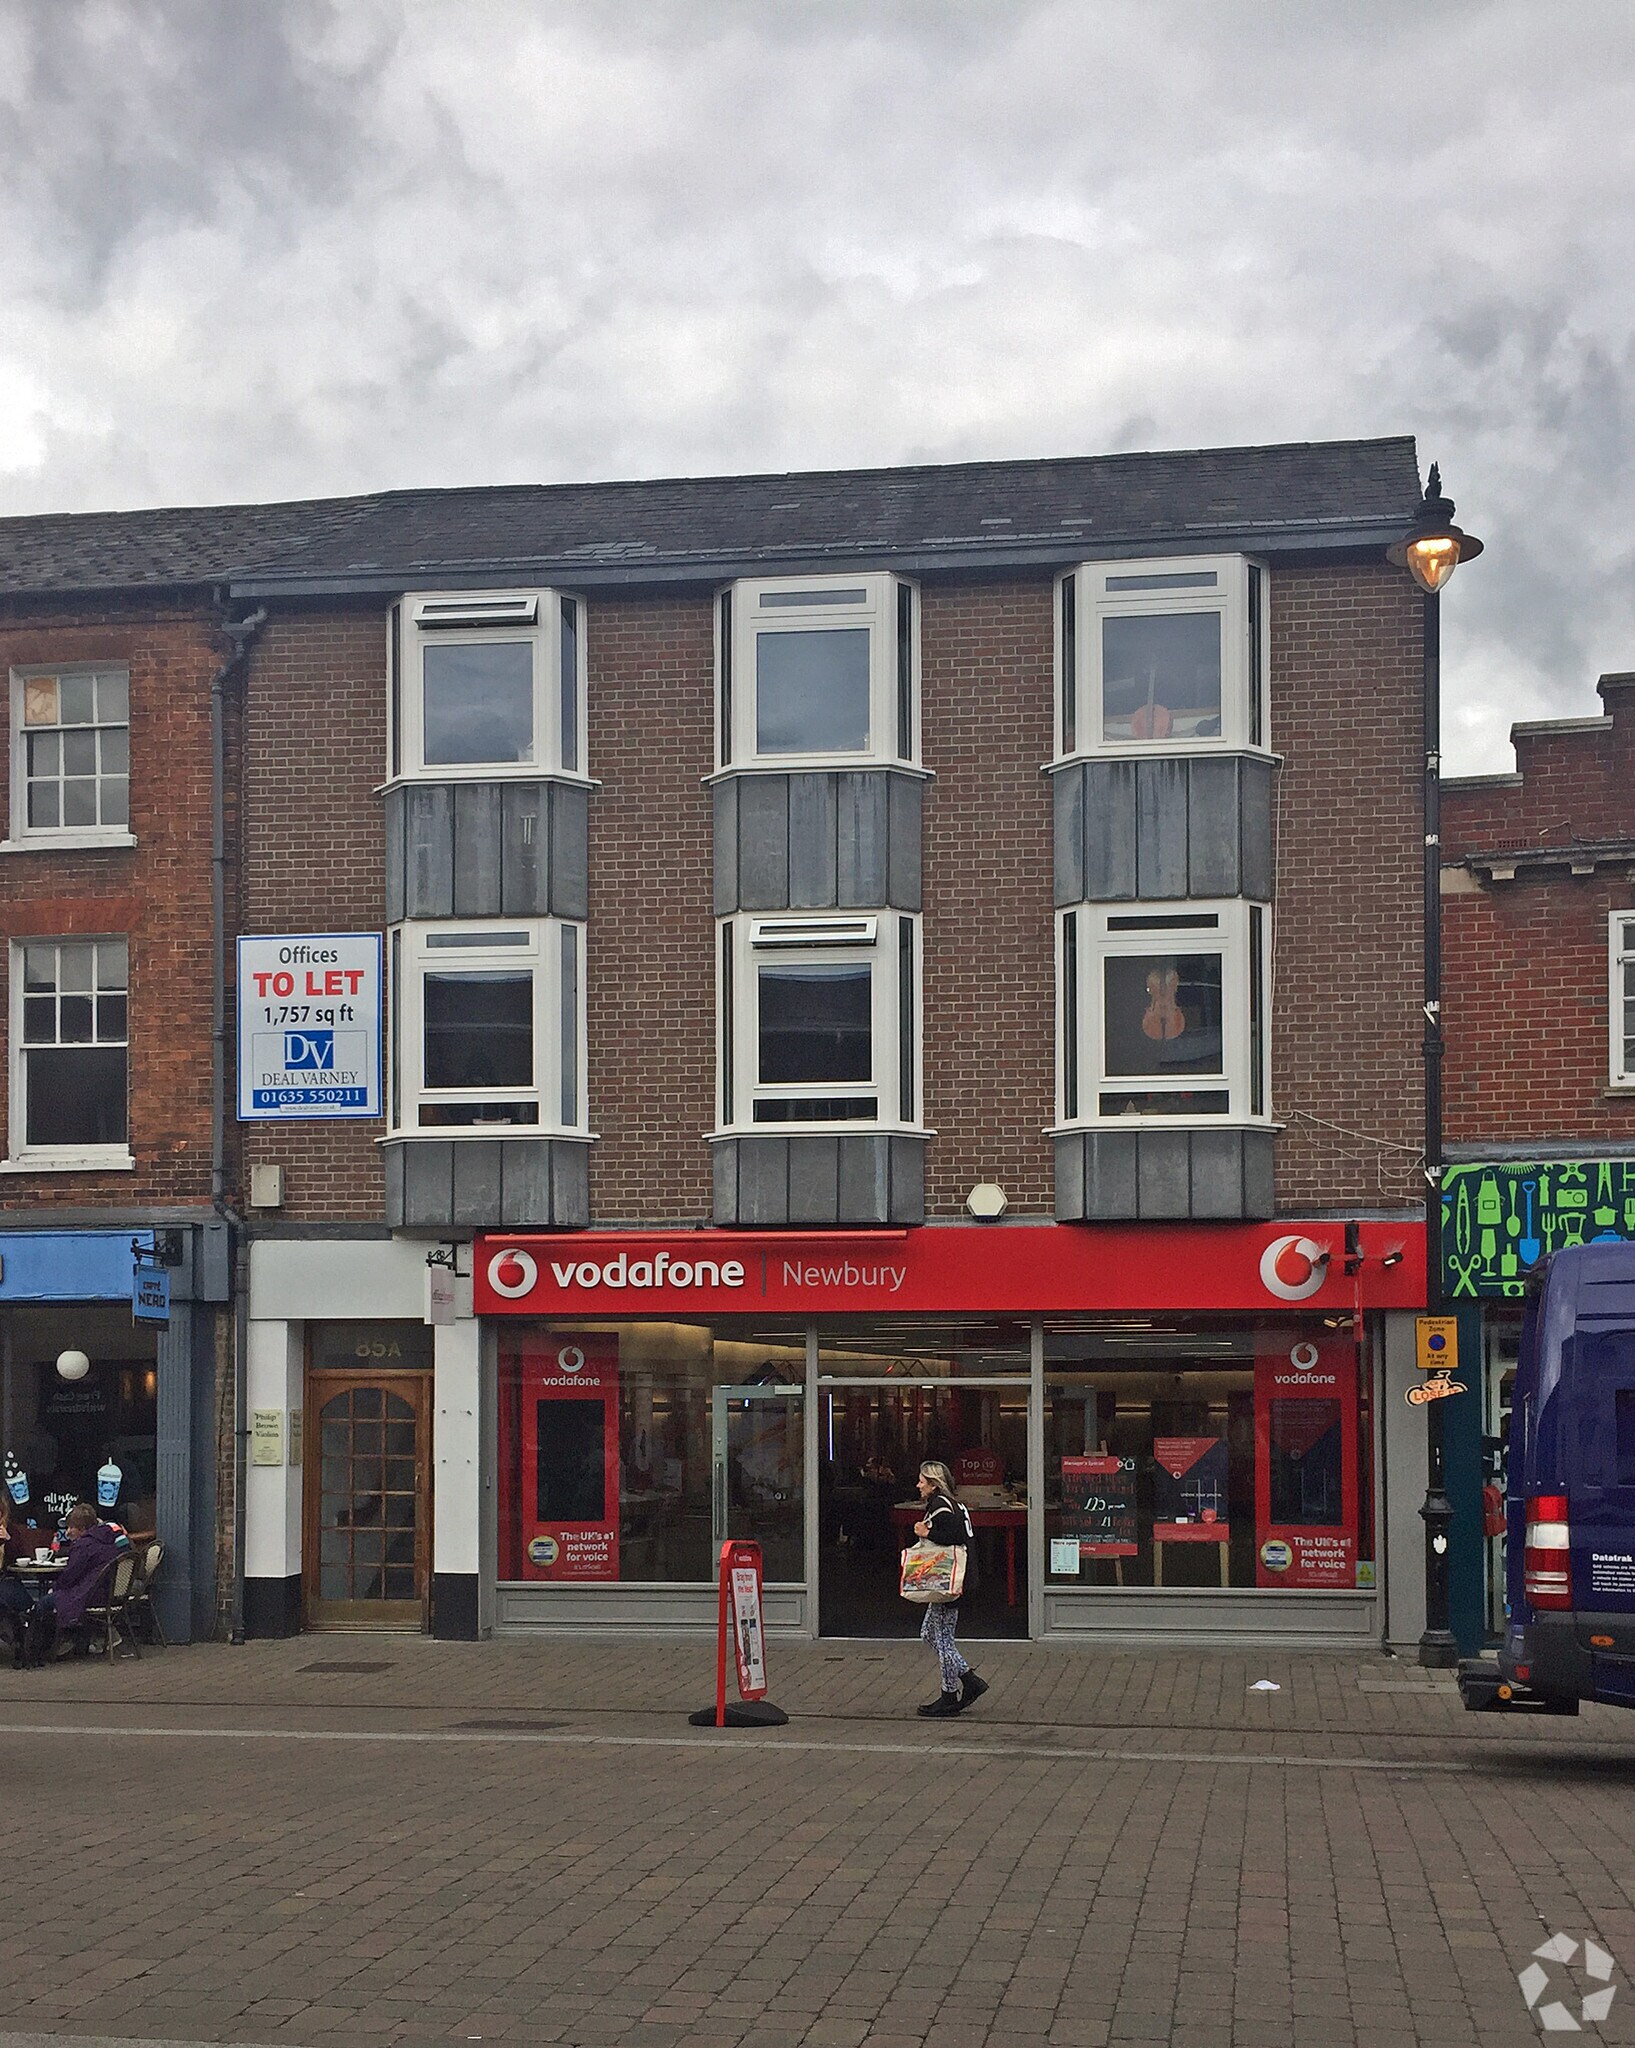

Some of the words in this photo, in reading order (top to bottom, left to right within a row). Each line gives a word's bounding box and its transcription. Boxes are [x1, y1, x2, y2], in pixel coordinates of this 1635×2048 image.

[279, 945, 338, 964] Offices
[252, 971, 295, 997] TO
[306, 970, 365, 996] LET
[264, 1006, 310, 1026] 1,757
[315, 1009, 334, 1026] sq
[339, 1003, 354, 1022] ft
[285, 1033, 334, 1070] DV
[262, 1072, 299, 1086] DEAL
[301, 1071, 358, 1085] VARNEY
[261, 1091, 306, 1103] 01635
[309, 1089, 360, 1102] 550211
[550, 1251, 745, 1289] vodafone
[782, 1260, 907, 1292] Newbury
[542, 1374, 601, 1386] vodafone
[1274, 1373, 1336, 1384] vodafone
[1413, 1390, 1444, 1401] LOSE
[254, 1412, 277, 1422] Philip
[961, 1459, 980, 1470] Top
[44, 1492, 57, 1503] all
[58, 1493, 79, 1502] new
[560, 1531, 579, 1541] The
[580, 1531, 602, 1541] UK's
[1293, 1536, 1313, 1546] The
[1314, 1537, 1339, 1547] UK's
[567, 1541, 608, 1551] network
[566, 1552, 581, 1561] for
[582, 1552, 609, 1561] voice
[1301, 1549, 1345, 1558] network
[1592, 1553, 1633, 1562] Datatrak
[1300, 1559, 1316, 1568] for
[1317, 1559, 1346, 1569] voice
